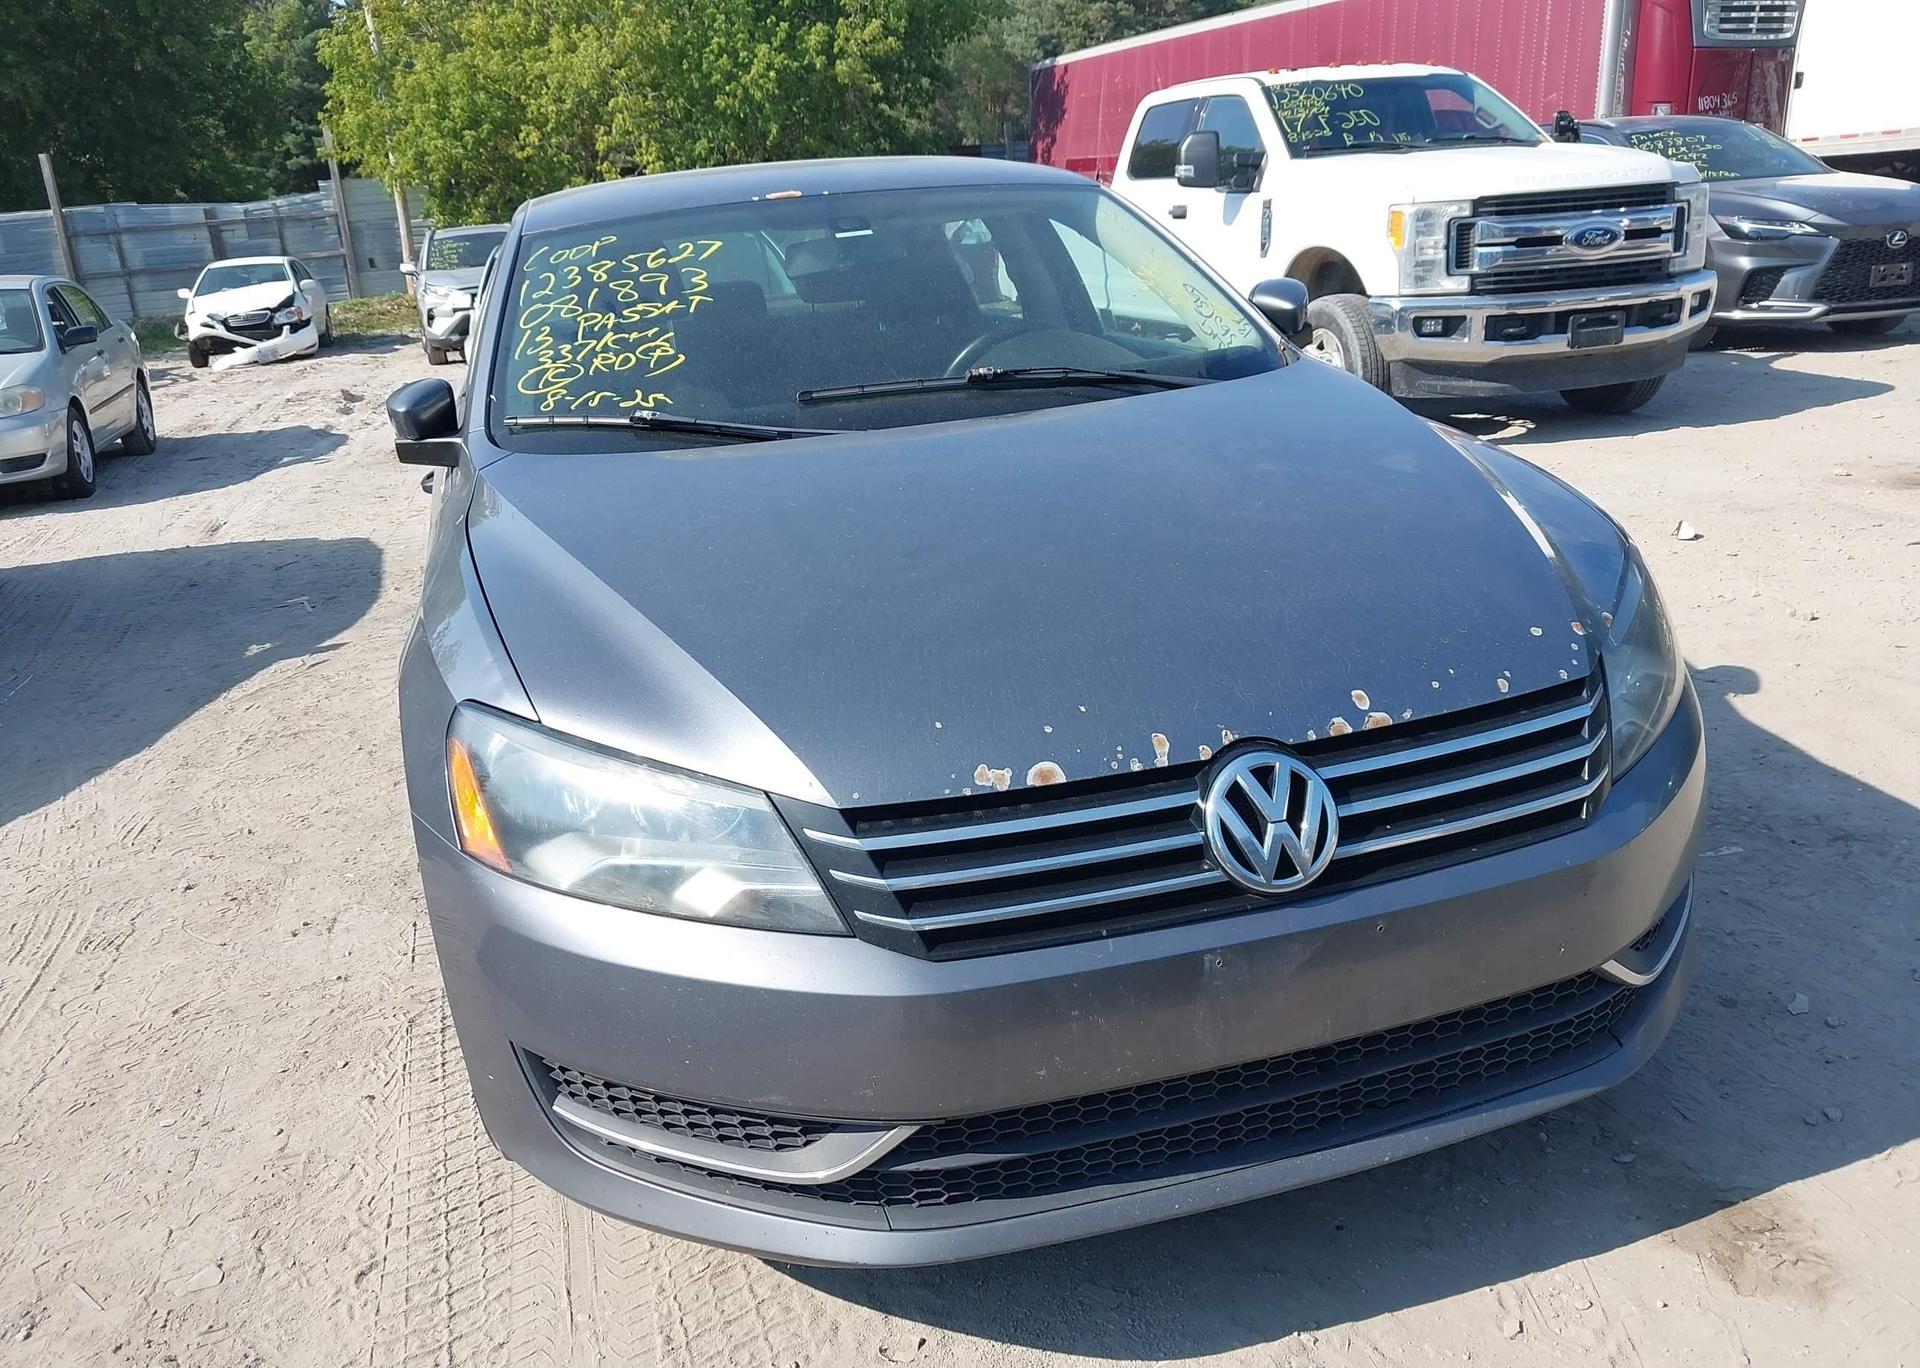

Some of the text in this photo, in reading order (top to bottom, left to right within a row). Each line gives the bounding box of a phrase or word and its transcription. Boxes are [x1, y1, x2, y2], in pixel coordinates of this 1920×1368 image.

[1582, 230, 1611, 246] Ford
[519, 241, 724, 307] 12385627
[519, 267, 710, 329] 081893
[576, 295, 714, 343] PASSAT
[540, 389, 675, 411] 8-15-25
